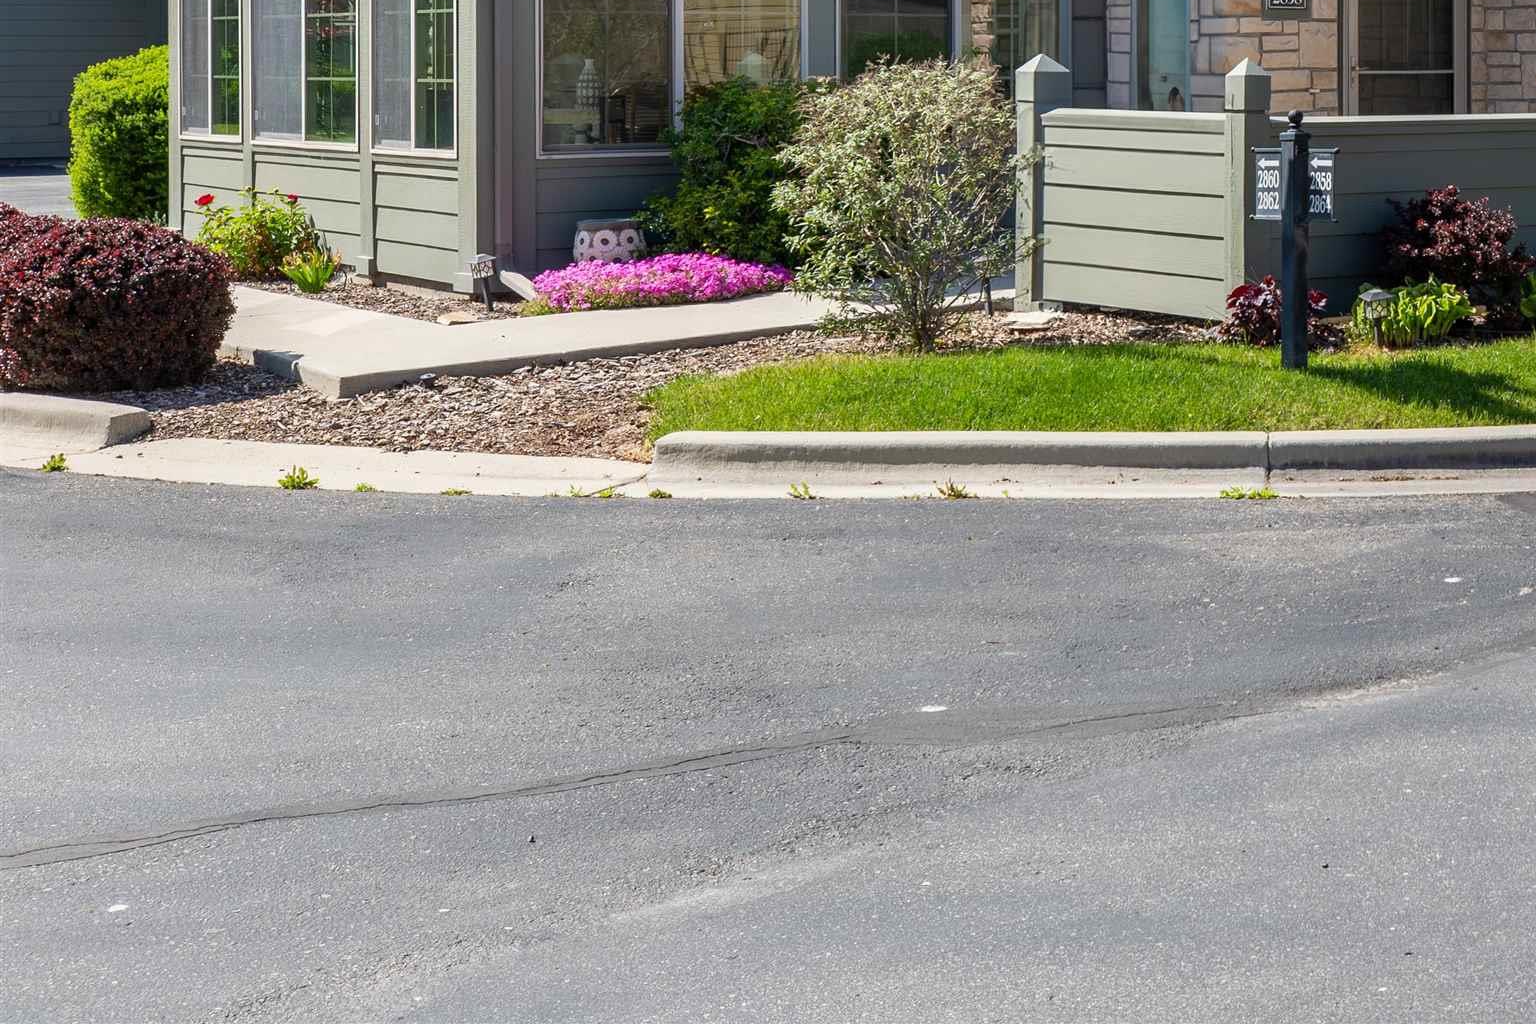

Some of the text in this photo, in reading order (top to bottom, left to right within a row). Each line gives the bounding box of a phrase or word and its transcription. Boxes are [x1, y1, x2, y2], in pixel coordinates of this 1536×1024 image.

[1257, 169, 1280, 188] 2860
[1310, 171, 1332, 191] 2858
[1257, 191, 1280, 210] 2862
[1308, 194, 1331, 214] 2864
